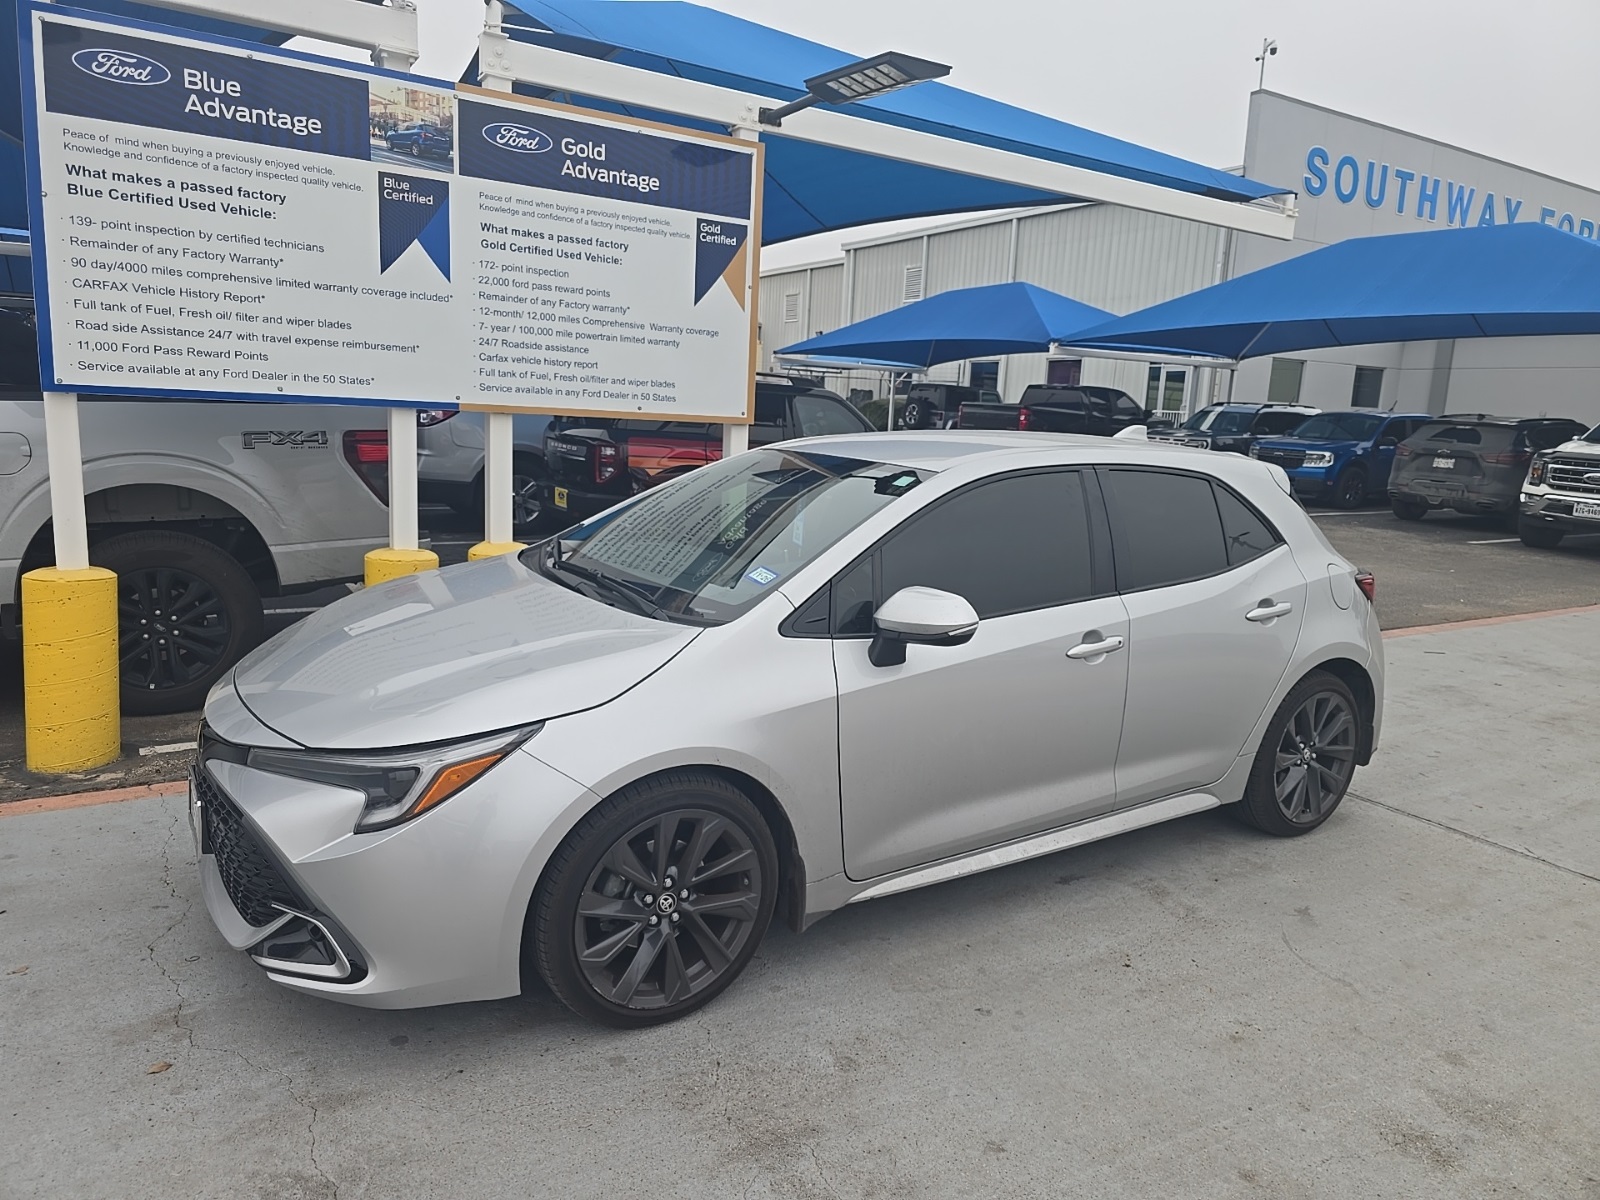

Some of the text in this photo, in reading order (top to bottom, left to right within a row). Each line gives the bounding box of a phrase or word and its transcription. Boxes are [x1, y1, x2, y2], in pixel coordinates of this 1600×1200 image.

[91, 49, 152, 84] Ford
[183, 68, 242, 98] Blue
[184, 94, 323, 136] Advantage
[495, 123, 540, 150] Ford
[561, 137, 606, 161] Gold
[62, 127, 95, 140] Peace
[98, 134, 108, 142] of
[114, 136, 139, 147] mind
[141, 140, 168, 151] when
[171, 143, 203, 158] buying
[215, 152, 262, 166] previously
[264, 159, 299, 170] enjoyed
[302, 165, 335, 175] vehicle.
[63, 141, 120, 158] Knowledge
[123, 151, 142, 160] and
[145, 155, 198, 168] confidence
[201, 161, 210, 169] of
[221, 163, 253, 177] factory
[255, 168, 298, 182] inspected
[300, 177, 329, 188] quality
[331, 181, 363, 191] vehicle.
[561, 160, 660, 192] Advantage
[65, 163, 286, 205] What makes a passed factory
[383, 176, 410, 191] Blue
[383, 188, 434, 206] Certified
[1303, 145, 1524, 228] SOUTHWAY
[67, 182, 276, 219] Blue Certified Used Vehicle:
[68, 215, 324, 252] 139- point inspection by certified technicians
[480, 222, 508, 234] What
[511, 228, 544, 239] makes
[556, 234, 592, 245] passed
[595, 237, 628, 252] factory
[699, 232, 737, 246] Certified
[700, 222, 721, 234] Gold
[69, 235, 138, 252] Remainder
[141, 244, 154, 253] of
[156, 247, 178, 258] any
[182, 247, 226, 263] Factory
[480, 238, 622, 265] Gold Certified Used Vehicle:
[70, 256, 86, 267] 90
[90, 259, 147, 273] day/4000
[151, 265, 182, 277] miles
[186, 270, 272, 285] comprehensive
[275, 277, 310, 288] limited
[313, 282, 358, 295] warranty
[361, 287, 407, 299] coverage
[501, 263, 523, 273] point
[525, 265, 569, 277] inspection
[72, 278, 128, 292] CARFAX
[131, 282, 175, 296] Vehicle
[179, 287, 219, 302] History
[478, 275, 610, 297] 22,000 ford pass reward points
[73, 298, 352, 329] Full tank of Fuel, Fresh oil/ filter and wiper blades
[478, 290, 528, 303] Remainder
[529, 296, 538, 304] of
[540, 299, 556, 308] any
[558, 298, 590, 312] Factory
[75, 319, 108, 331] Road
[112, 322, 137, 333] side
[140, 324, 204, 337] Assistance
[208, 329, 232, 339] 24/7
[235, 331, 258, 341] with
[261, 333, 291, 343] travel
[294, 337, 338, 347] expense
[526, 311, 556, 321] 12,000
[558, 315, 580, 323] miles
[582, 316, 645, 330] Comprehensive
[649, 322, 684, 335] Warranty
[685, 327, 719, 338] coverage
[77, 340, 268, 361] 11,000 Ford Pass Reward Points
[478, 337, 589, 354] 24/7 Roadside assistance
[77, 360, 124, 372] Service
[127, 364, 180, 375] available
[184, 367, 195, 376] at
[198, 369, 219, 379] any
[222, 368, 248, 378] Ford
[252, 370, 288, 380] Dealer
[290, 372, 300, 381] in
[303, 373, 319, 382] the
[322, 374, 335, 383] 50
[479, 367, 495, 376] Full
[497, 369, 516, 378] tank
[518, 370, 528, 378] of
[530, 371, 551, 381] Fuel,
[553, 372, 577, 382] Fresh
[610, 377, 625, 385] and
[627, 379, 648, 387] wiper
[650, 379, 675, 388] blades
[478, 382, 512, 392] Service
[514, 386, 553, 395] available
[555, 387, 562, 395] in
[564, 389, 580, 398] any
[582, 388, 601, 398] Ford
[603, 390, 629, 399] Dealer
[640, 392, 650, 400] 50
[652, 393, 676, 402] States
[241, 430, 328, 449] FX4
